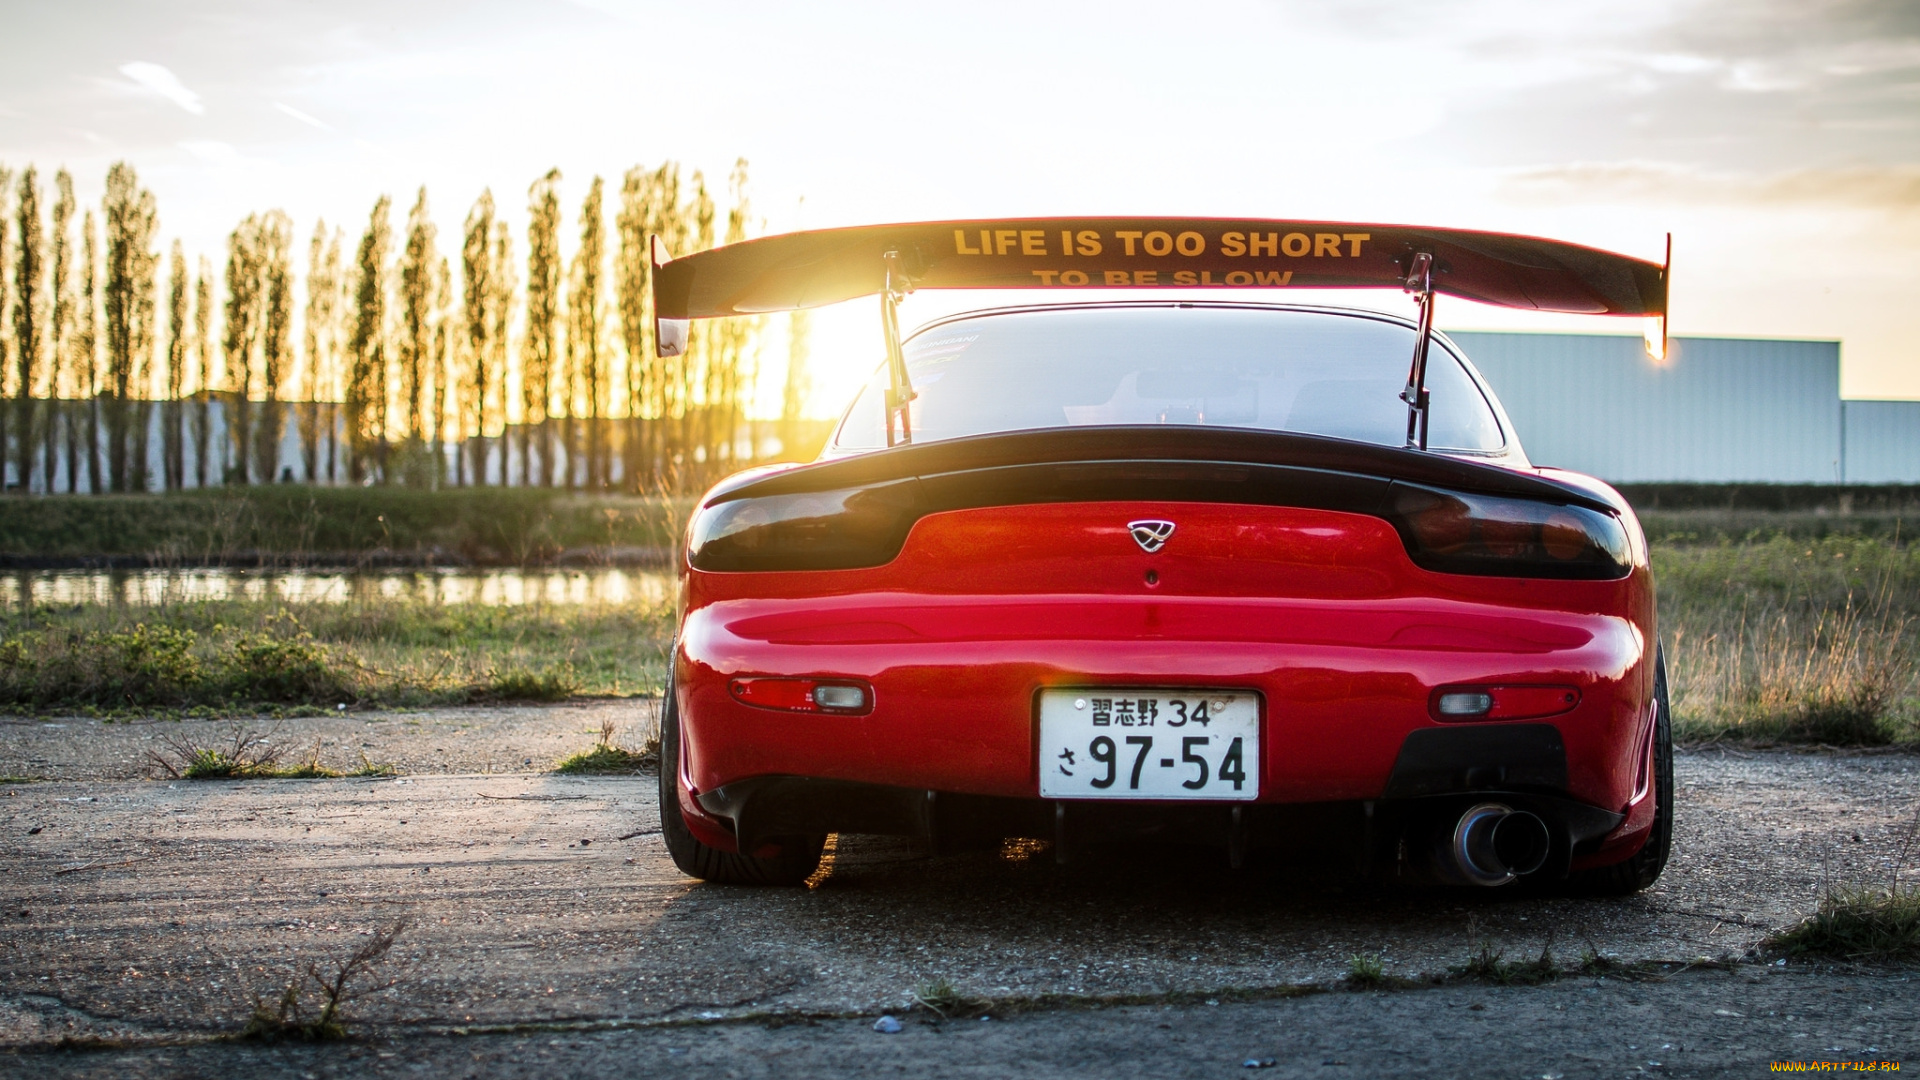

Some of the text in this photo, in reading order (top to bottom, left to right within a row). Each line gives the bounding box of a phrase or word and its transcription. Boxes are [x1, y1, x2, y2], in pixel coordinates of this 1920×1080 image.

[954, 229, 1371, 258] LIFE IS TOO SHORT
[1032, 270, 1293, 287] TO BE SLOW
[1091, 698, 1211, 727] 習志野 34
[1058, 735, 1246, 791] さ 97-54
